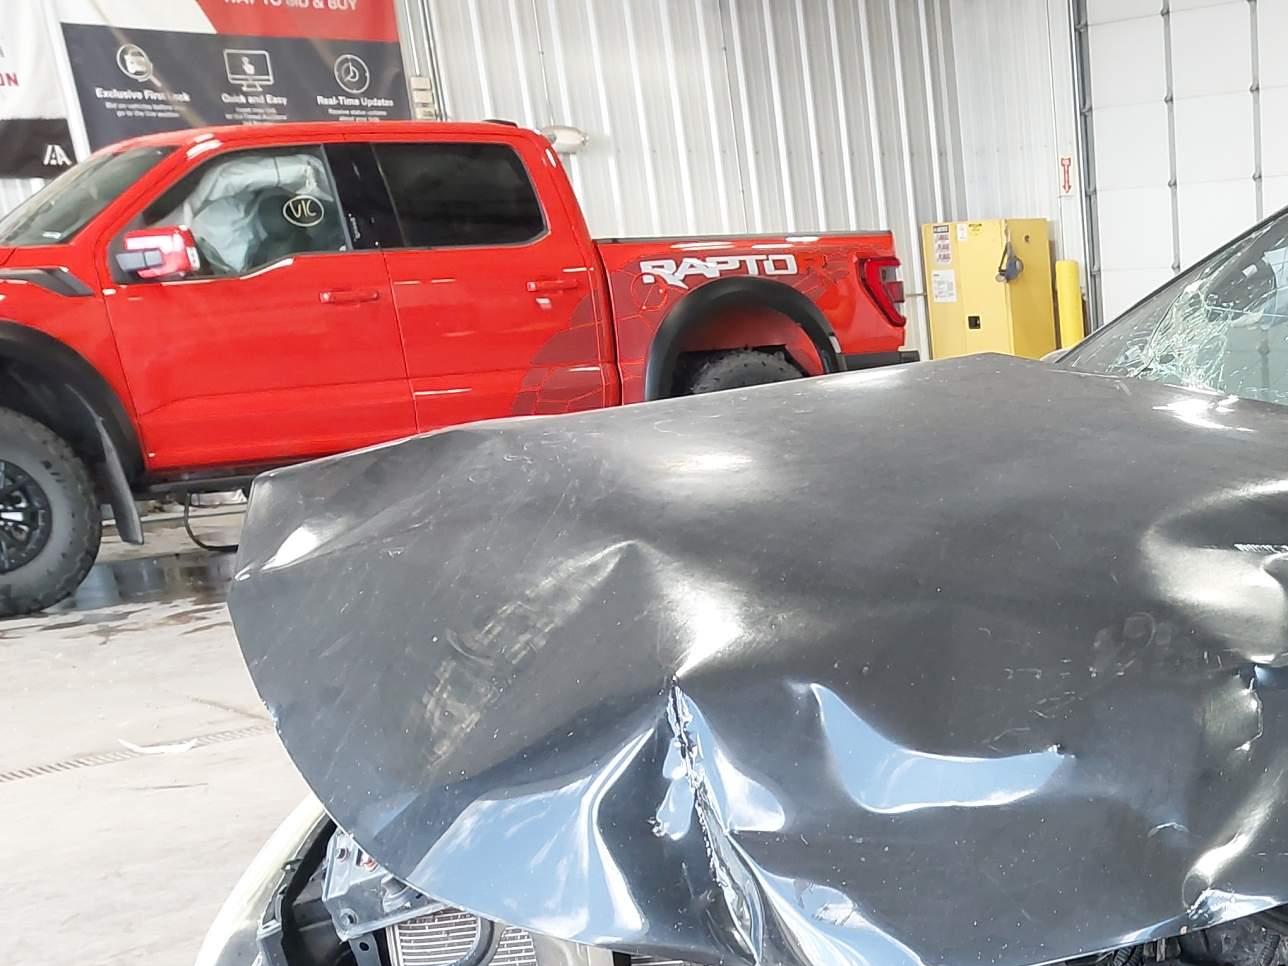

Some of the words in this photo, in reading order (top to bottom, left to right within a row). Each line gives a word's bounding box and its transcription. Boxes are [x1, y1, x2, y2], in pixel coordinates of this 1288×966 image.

[95, 87, 143, 100] Exclusive
[221, 93, 247, 105] Quick
[248, 94, 265, 105] and
[266, 95, 288, 106] Easy
[317, 95, 360, 106] Real-Time
[361, 97, 394, 108] Updates
[640, 254, 797, 290] RAPTO
